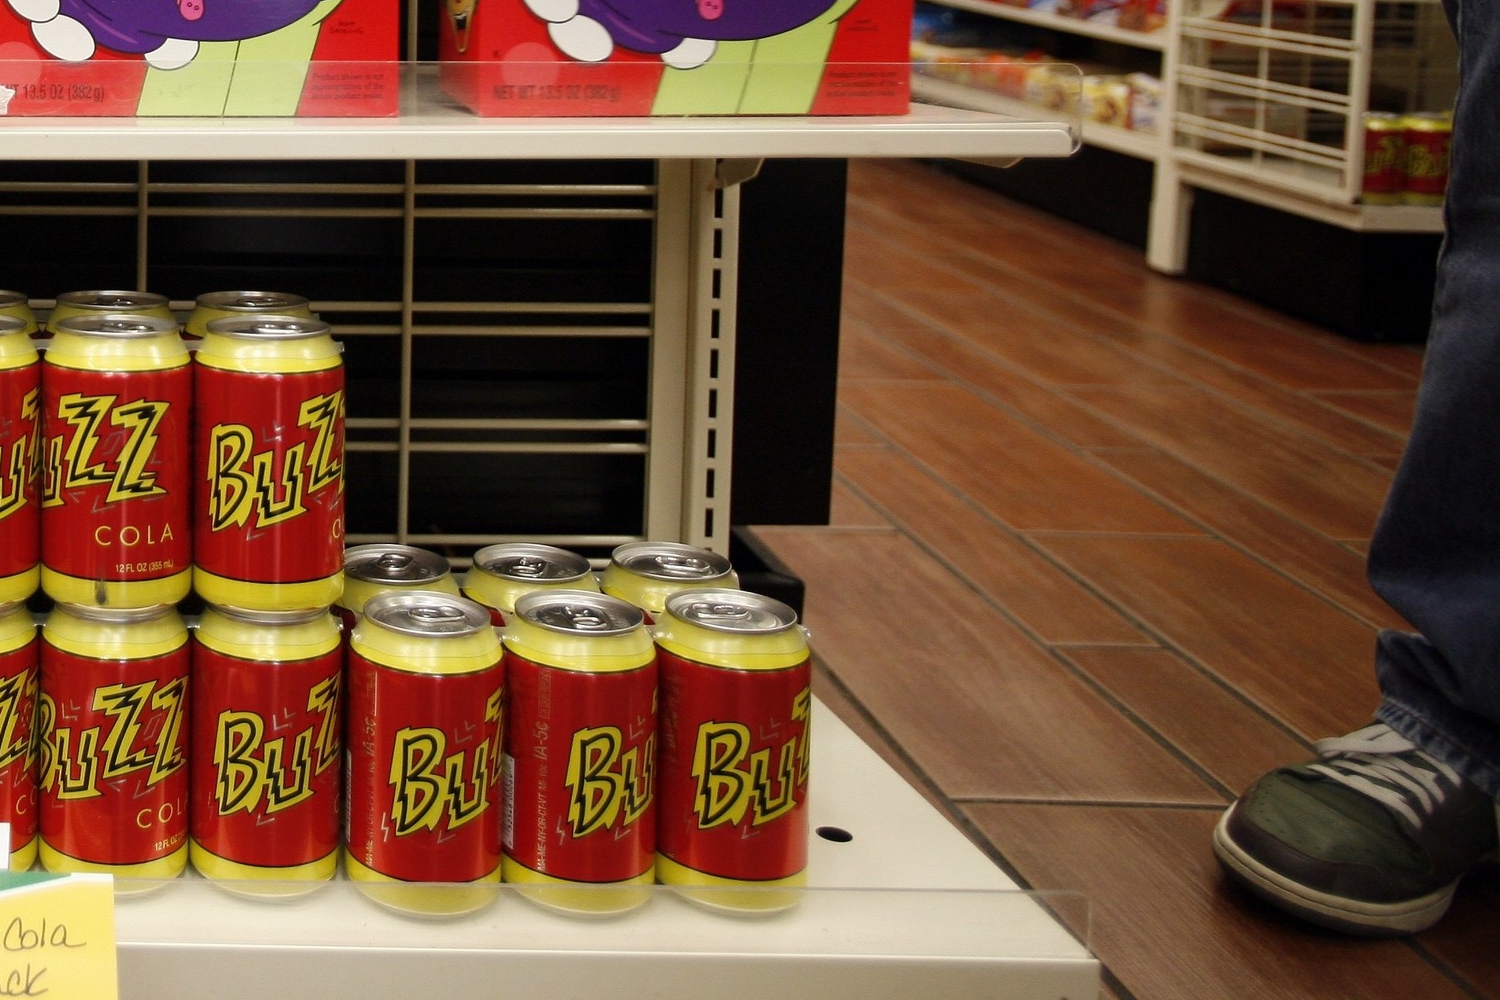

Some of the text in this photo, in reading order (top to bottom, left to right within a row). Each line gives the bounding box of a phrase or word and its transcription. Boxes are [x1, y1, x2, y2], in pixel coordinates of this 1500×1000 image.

[207, 390, 345, 533] BUZ
[94, 523, 174, 546] COLA
[565, 687, 657, 839] BU
[3, 917, 87, 951] Cola
